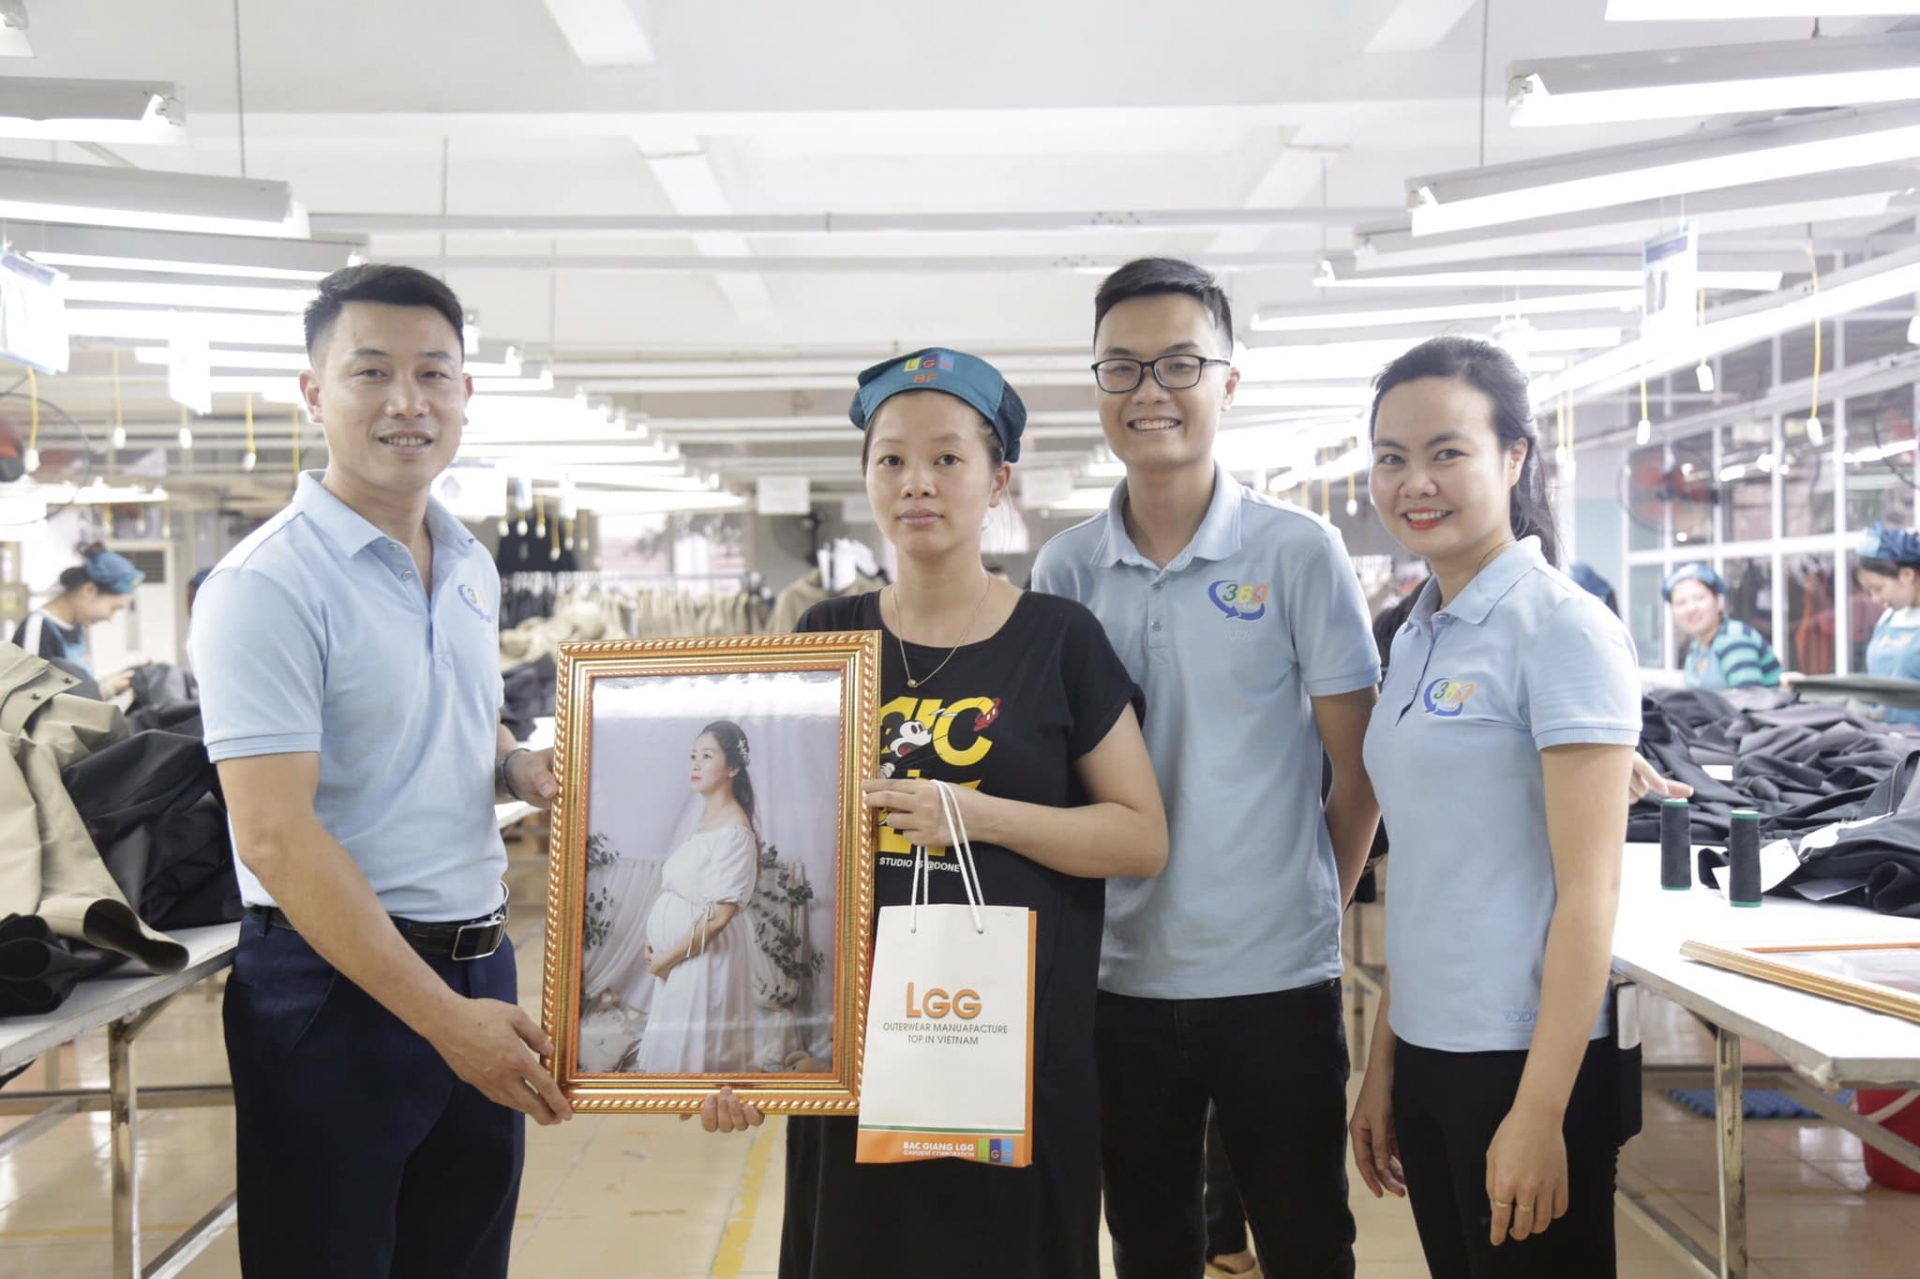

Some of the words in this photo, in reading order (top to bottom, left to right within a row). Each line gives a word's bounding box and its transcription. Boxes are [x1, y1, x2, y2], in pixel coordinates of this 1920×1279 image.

[1222, 583, 1269, 604] 360
[879, 856, 913, 868] STUDIO
[906, 981, 983, 1020] LGG
[882, 1022, 931, 1032] OUTERWEAR
[933, 1023, 1009, 1034] MANUAFACTURE
[908, 1034, 924, 1044] TOP
[925, 1035, 935, 1044] IN
[937, 1035, 979, 1045] VIETNAM
[903, 1141, 921, 1150] BAC
[922, 1142, 953, 1152] GIANG
